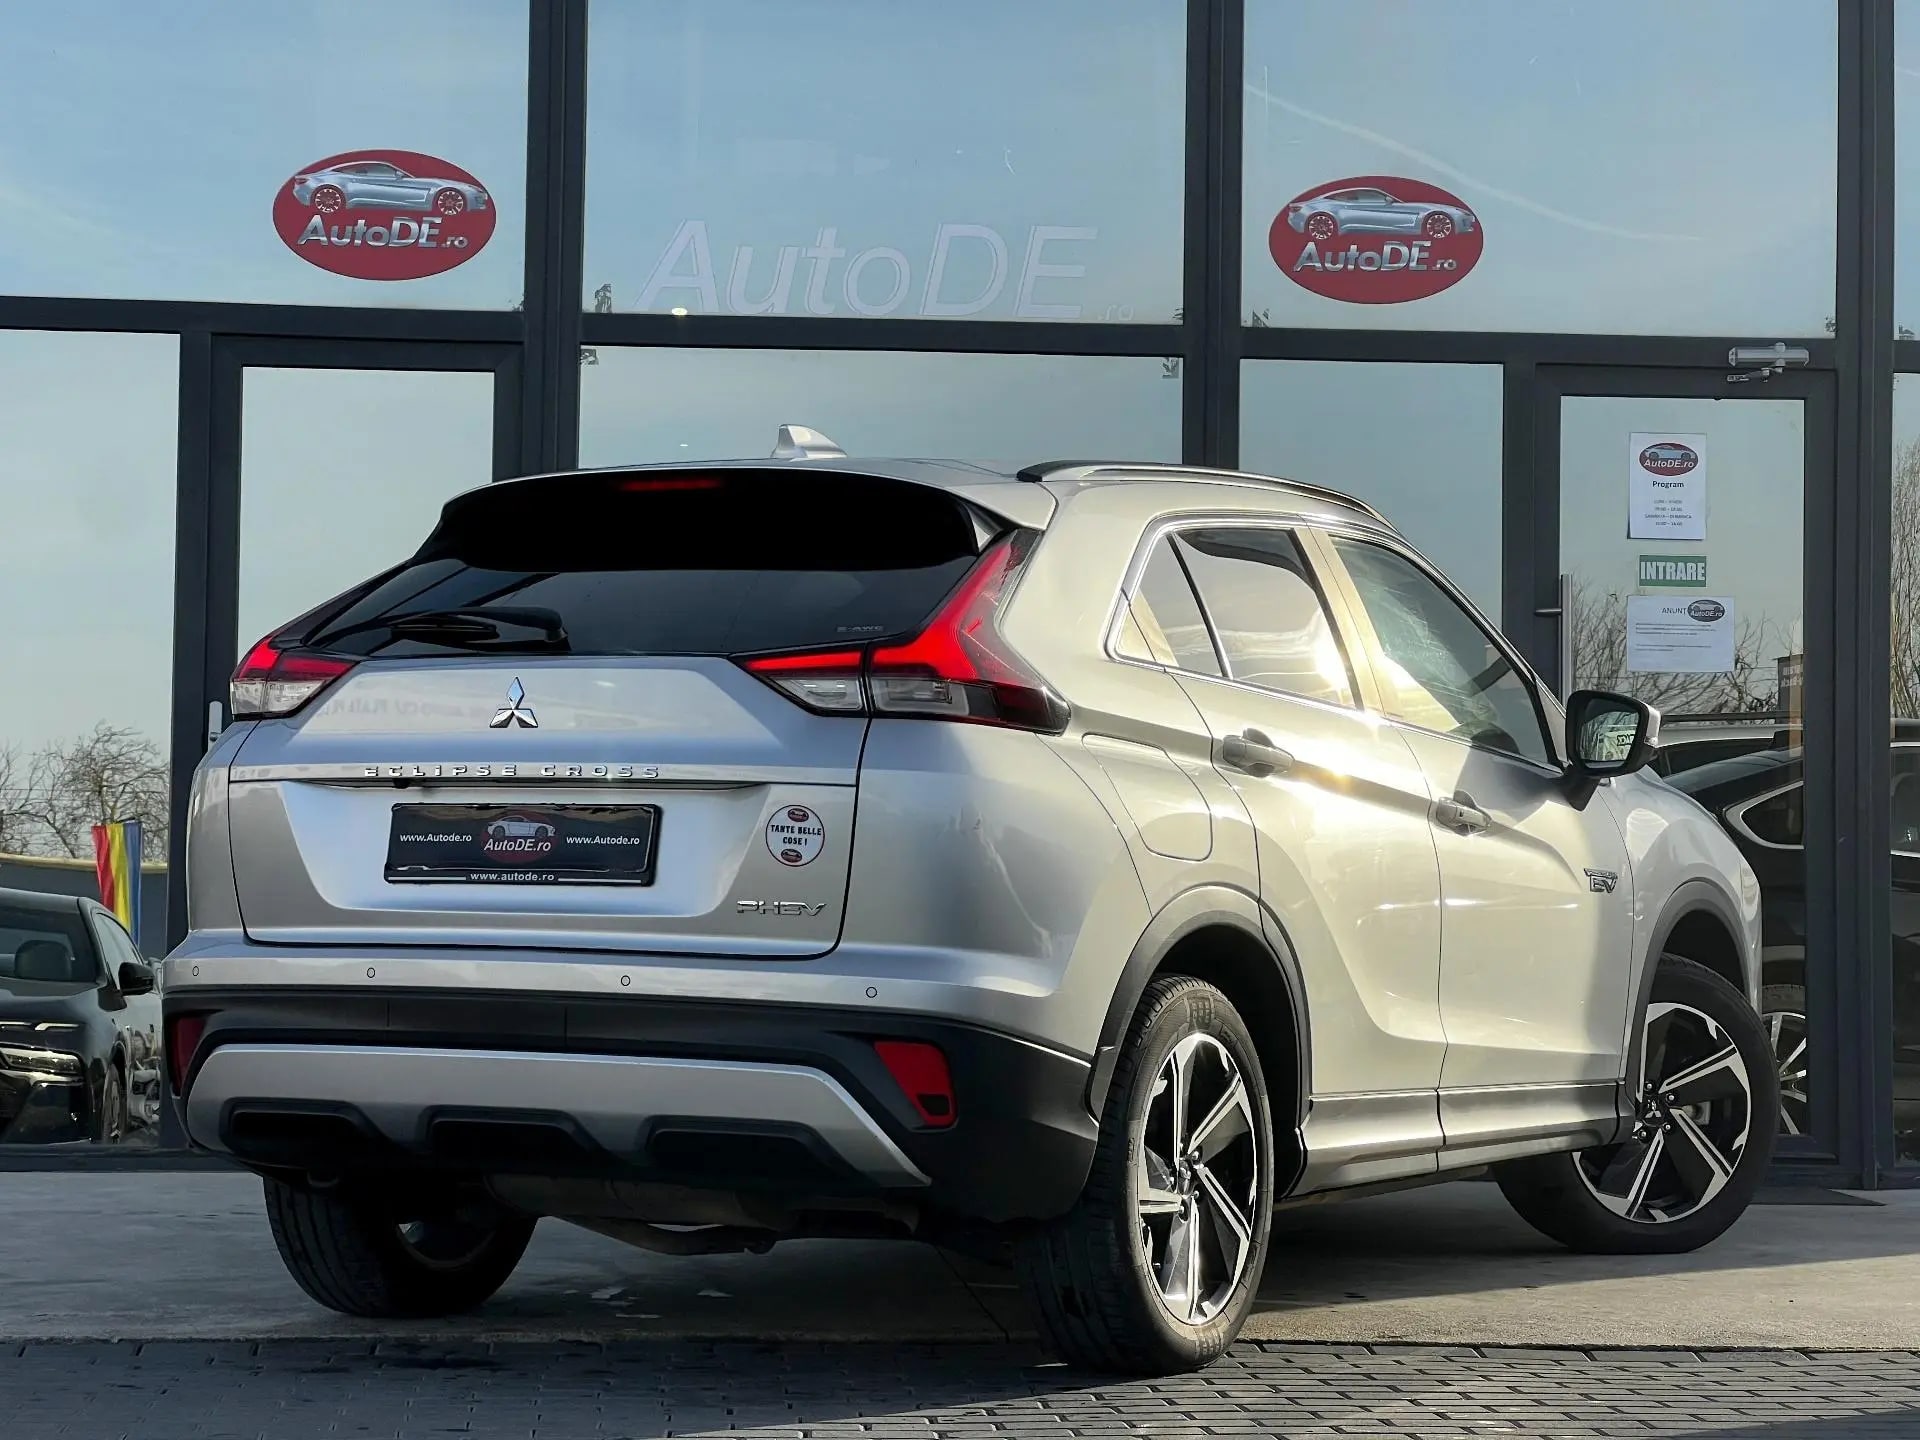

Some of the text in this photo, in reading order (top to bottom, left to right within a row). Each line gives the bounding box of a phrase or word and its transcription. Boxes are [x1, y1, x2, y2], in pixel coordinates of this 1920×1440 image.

[297, 214, 469, 248] AutoDE.ro
[1293, 240, 1458, 272] AutoDE.ro
[1643, 459, 1696, 469] AutoDE.ro
[1652, 480, 1685, 489] Program
[1640, 561, 1706, 581] INTRARE
[364, 764, 660, 779] ECLIPSE CROSS
[770, 824, 822, 836] TANTE BELLE
[399, 832, 473, 844] www.Autode.ro
[565, 833, 641, 846] www.Autode.ro
[782, 836, 803, 846] COSE
[483, 837, 552, 853] AutoDE.ro
[469, 871, 556, 883] www.autode.ro
[736, 900, 828, 917] PHEV
